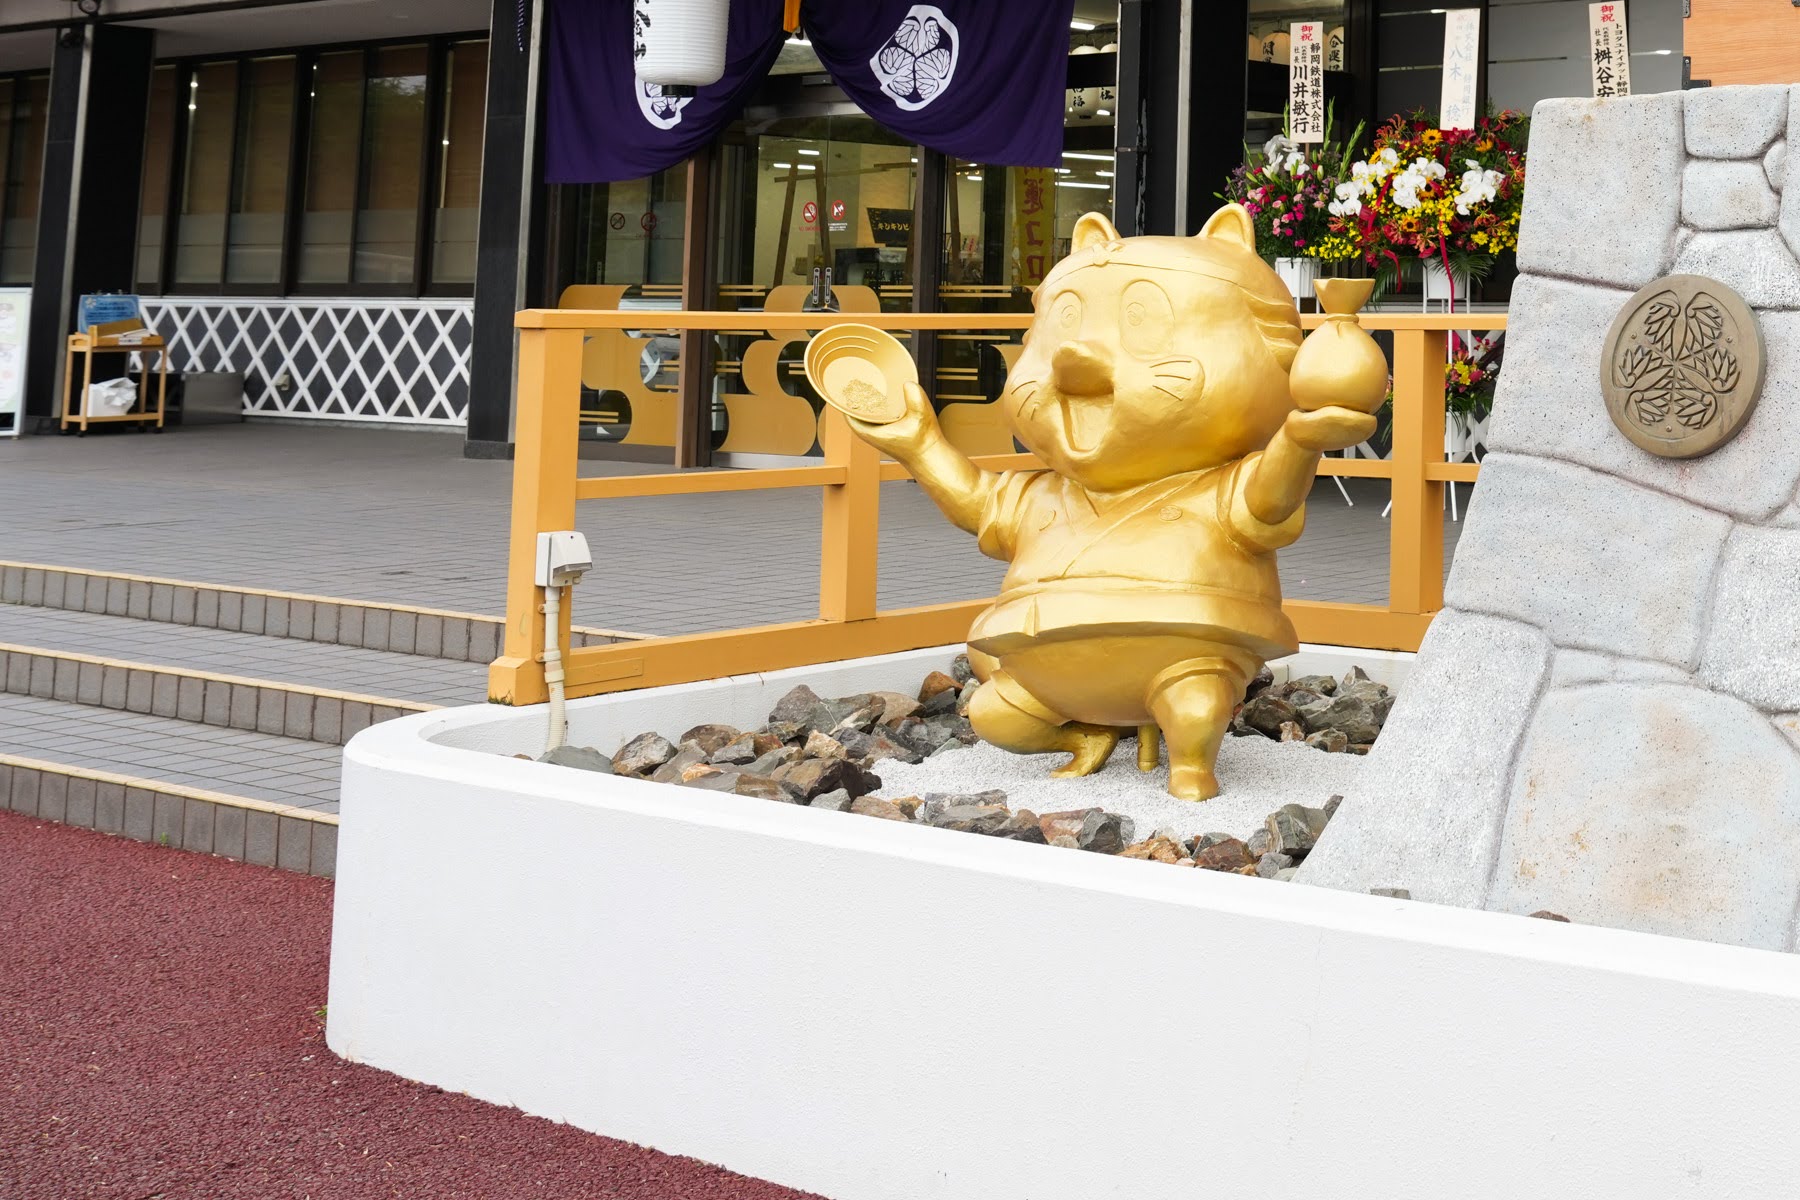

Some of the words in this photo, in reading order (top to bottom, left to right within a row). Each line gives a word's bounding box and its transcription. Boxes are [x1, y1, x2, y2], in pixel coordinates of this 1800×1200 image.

[1601, 5, 1615, 23] 御祝
[1300, 25, 1313, 41] 御祝
[1594, 28, 1601, 47] 社長
[1293, 46, 1300, 64] 社長
[1449, 46, 1463, 80] 八木
[1615, 23, 1628, 97] トヨタユナイテッド静岡
[1292, 65, 1310, 134] 川井敏行
[1310, 43, 1322, 133] 静岡鉄道株式会社
